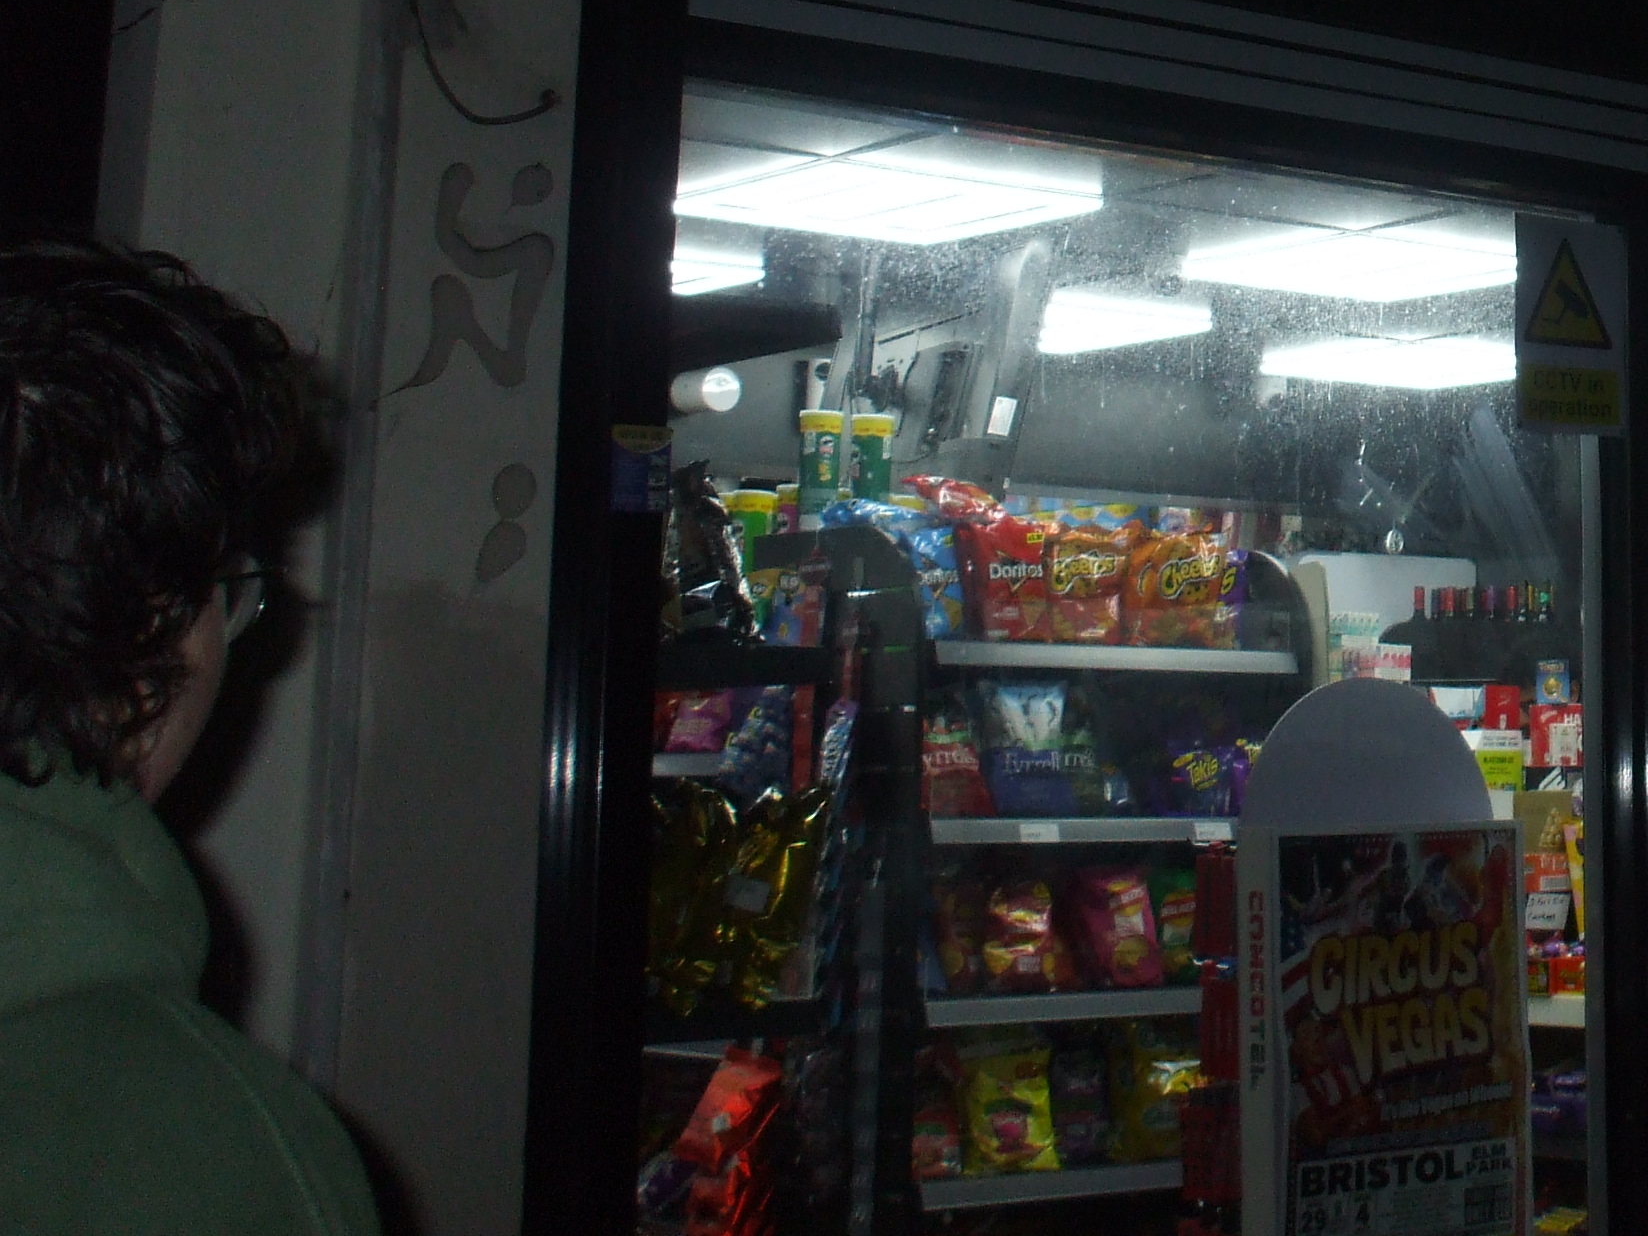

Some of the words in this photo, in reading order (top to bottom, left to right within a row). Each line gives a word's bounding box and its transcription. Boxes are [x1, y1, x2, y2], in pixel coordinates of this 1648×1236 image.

[1532, 368, 1583, 392] CCTV
[1587, 374, 1605, 395] in
[1526, 397, 1612, 421] operation
[989, 562, 1044, 580] Doritos
[1309, 920, 1479, 1016] CIRCUS
[1342, 987, 1491, 1085] VEGAS
[1471, 1142, 1507, 1161] ELM
[1300, 1149, 1463, 1198] BRISTOL
[1465, 1157, 1513, 1176] PARK
